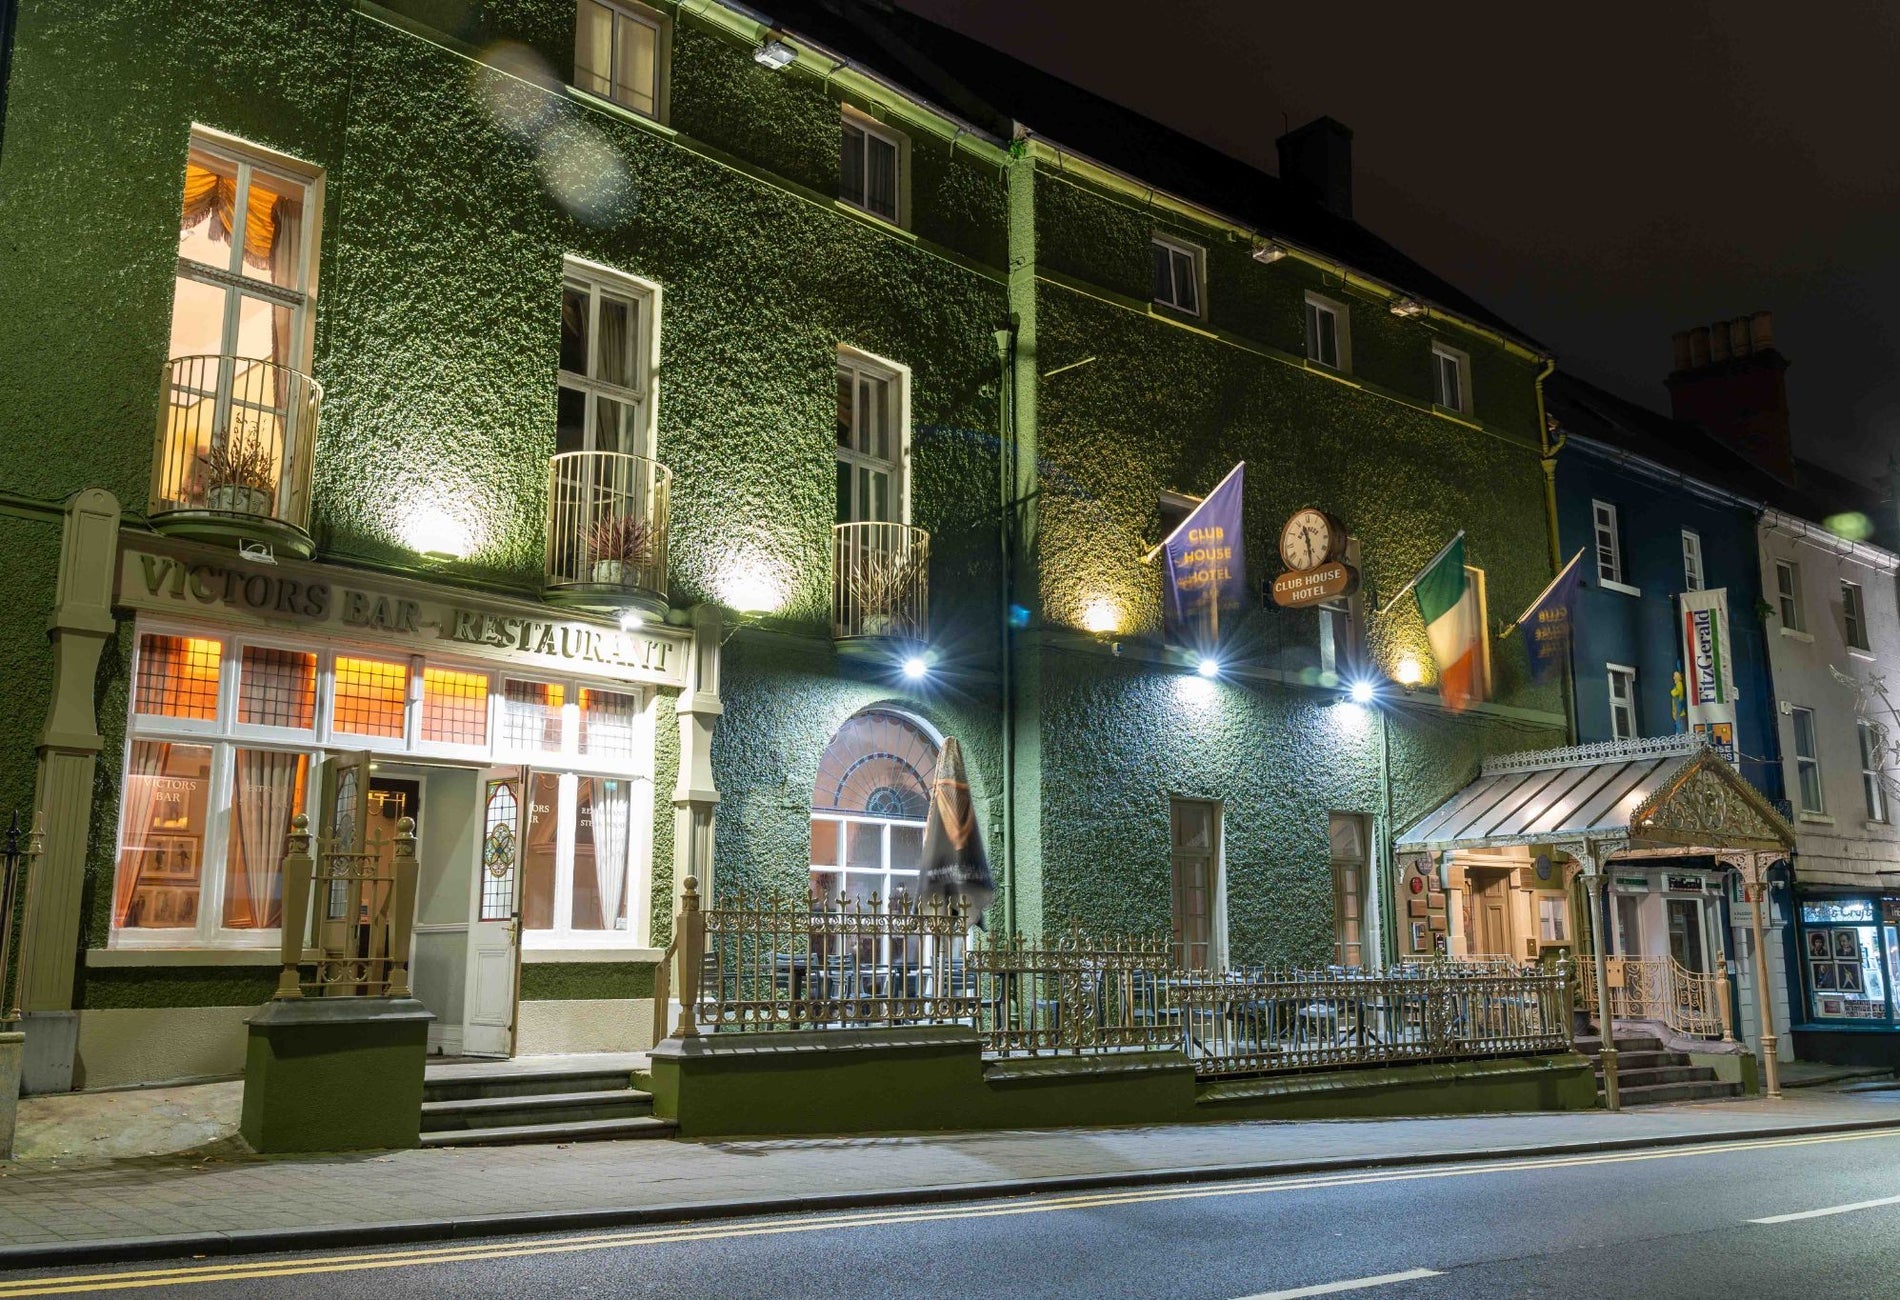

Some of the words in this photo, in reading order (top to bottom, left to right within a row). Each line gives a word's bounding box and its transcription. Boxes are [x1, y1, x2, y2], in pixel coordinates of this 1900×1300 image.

[1188, 526, 1224, 542] CLUB
[1183, 547, 1232, 562] HOUSE
[1275, 578, 1302, 592] CLUB
[1305, 568, 1341, 585] HOUSE
[140, 554, 329, 617] VICTORS
[342, 590, 421, 633] BAR
[1292, 585, 1326, 600] HOTEL
[1694, 609, 1716, 705] FitzGerald
[143, 777, 197, 791] VICTORS
[156, 791, 181, 802] BAR
